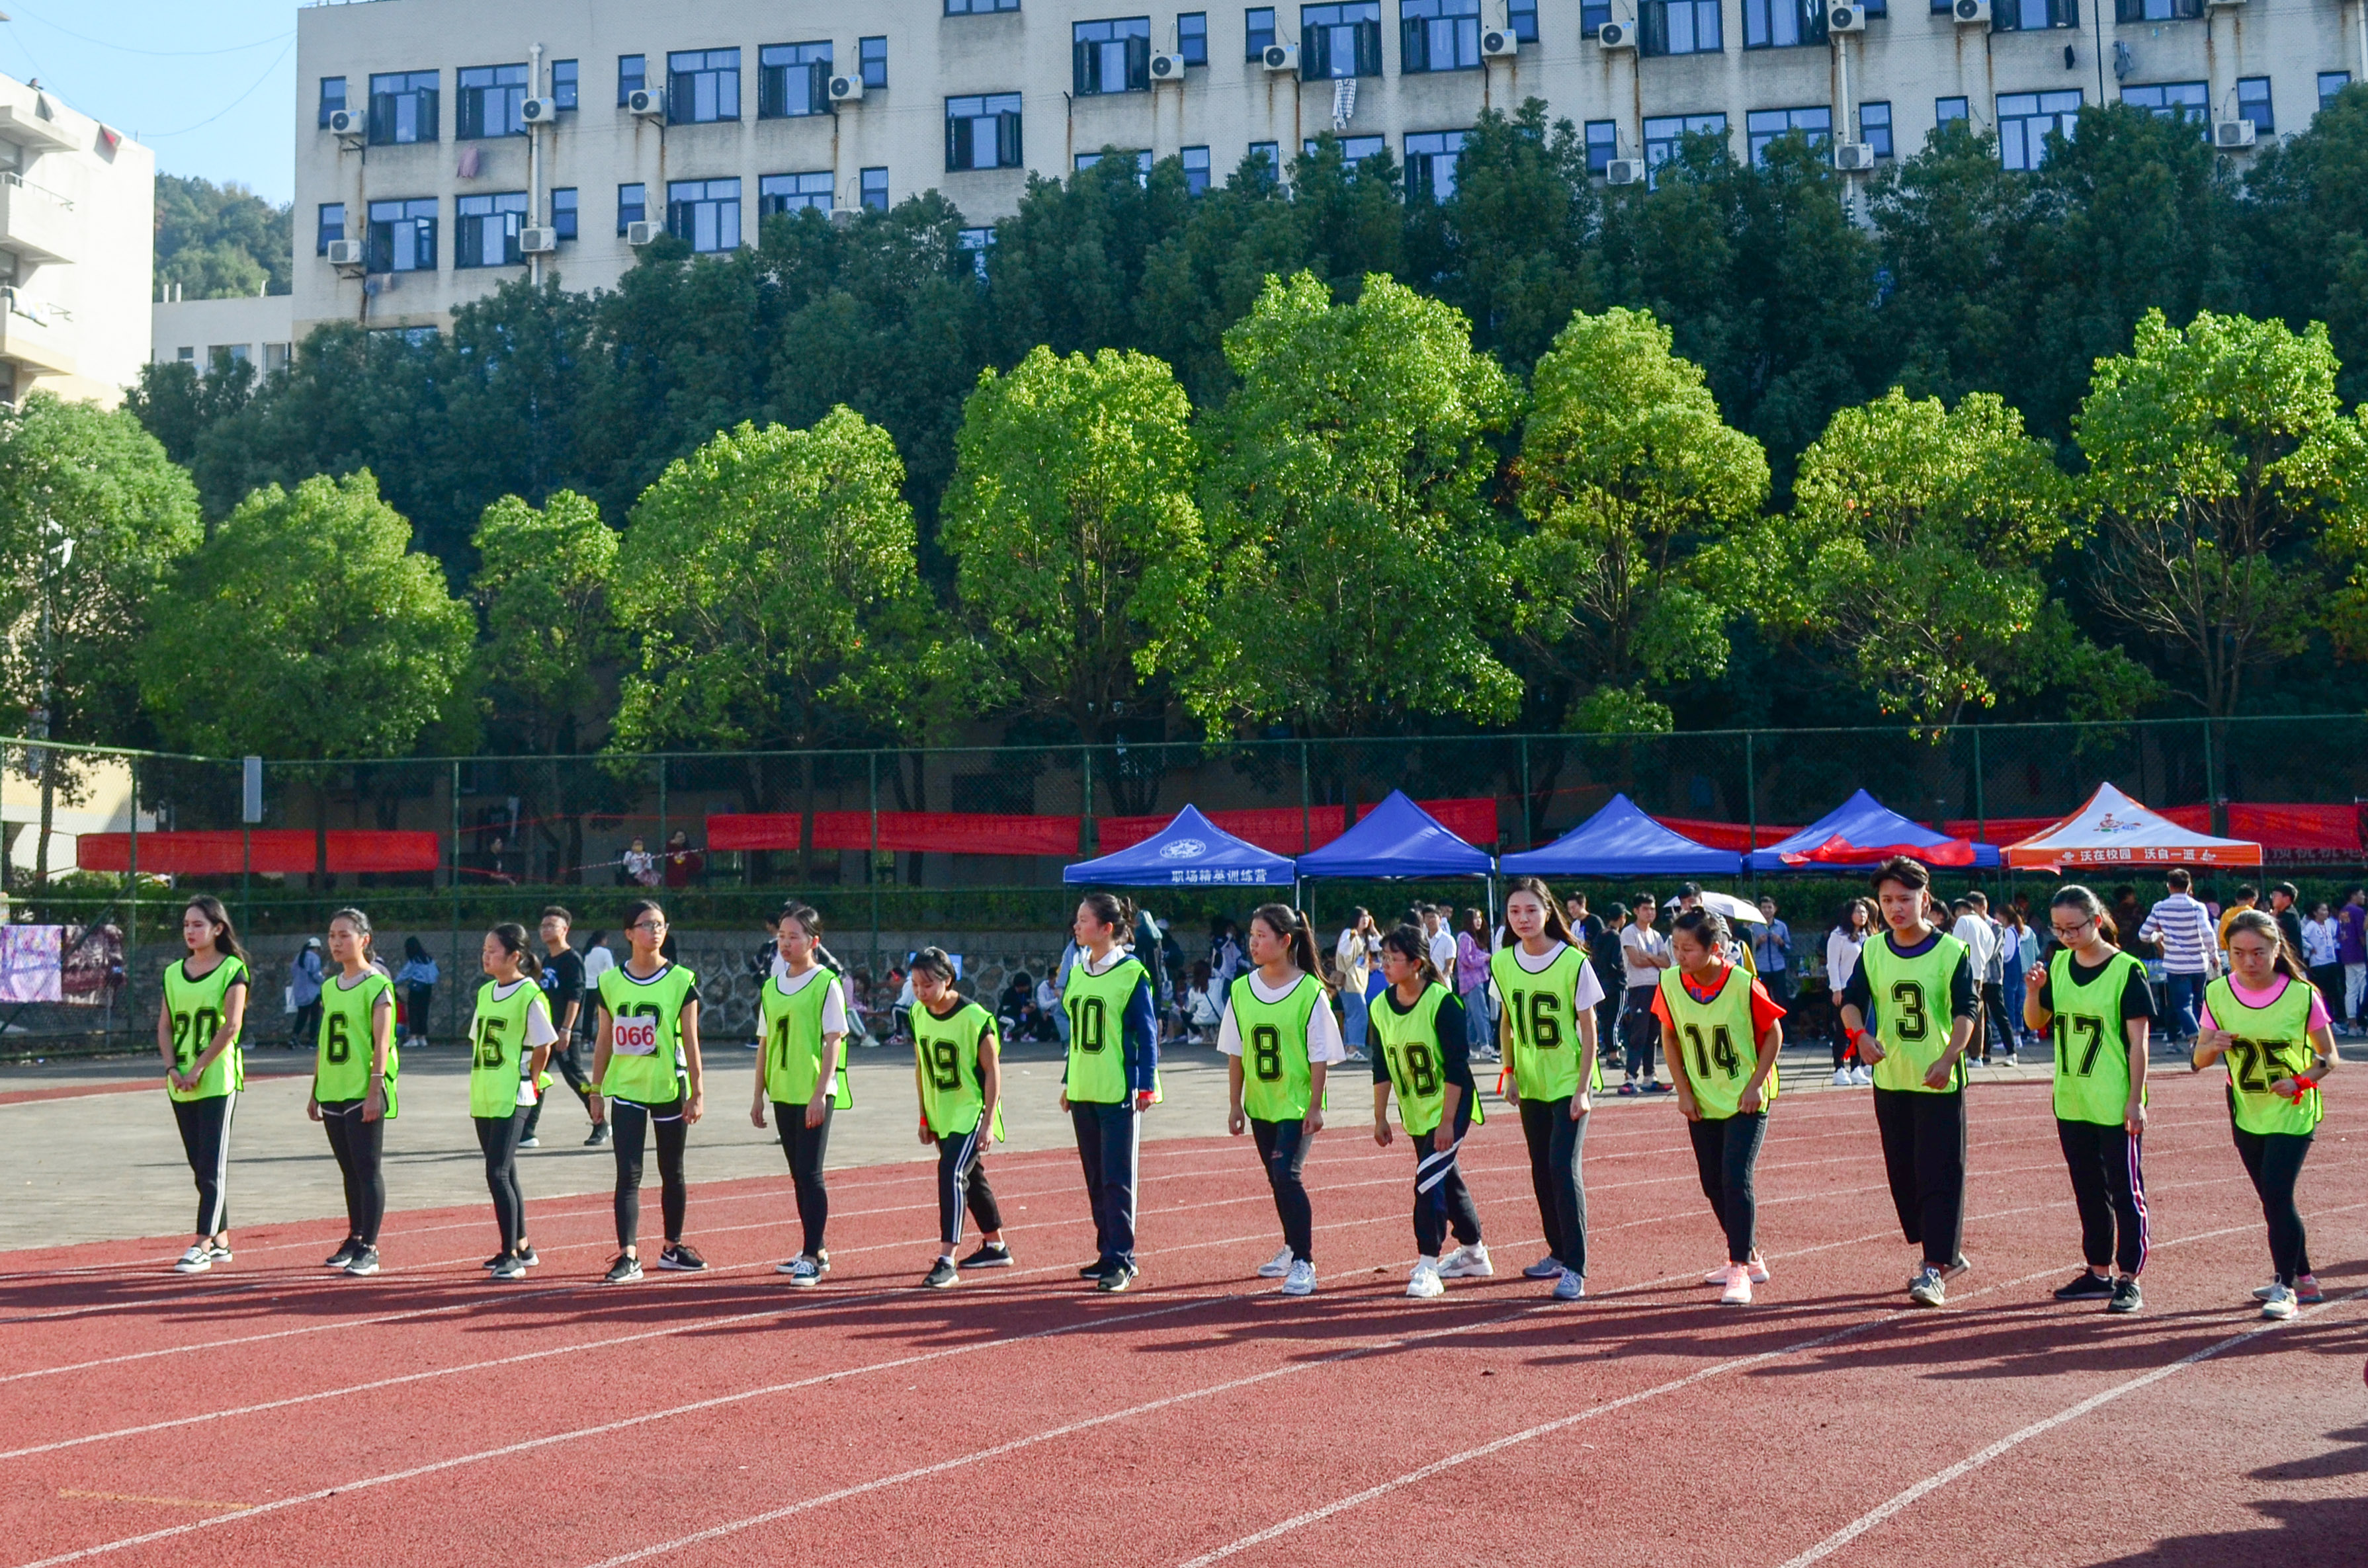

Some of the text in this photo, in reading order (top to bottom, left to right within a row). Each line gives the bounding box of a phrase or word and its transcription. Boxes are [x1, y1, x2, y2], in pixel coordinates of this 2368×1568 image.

[1171, 868, 1267, 883] 职场精英训练营
[2080, 849, 2131, 861] 沃在校园
[174, 1007, 219, 1065] 20
[326, 1011, 351, 1065] 6
[614, 1024, 655, 1047] 066
[1068, 995, 1107, 1055] 10
[1513, 989, 1563, 1050] 16
[1891, 979, 1929, 1042] 3
[473, 1016, 508, 1070] 15
[777, 1014, 791, 1071] 1
[919, 1035, 963, 1094] 19
[1251, 1024, 1283, 1083] 8
[1388, 1042, 1439, 1098] 18
[1683, 1023, 1740, 1079] 14
[2054, 1012, 2105, 1078] 17
[2230, 1039, 2293, 1094] 25
